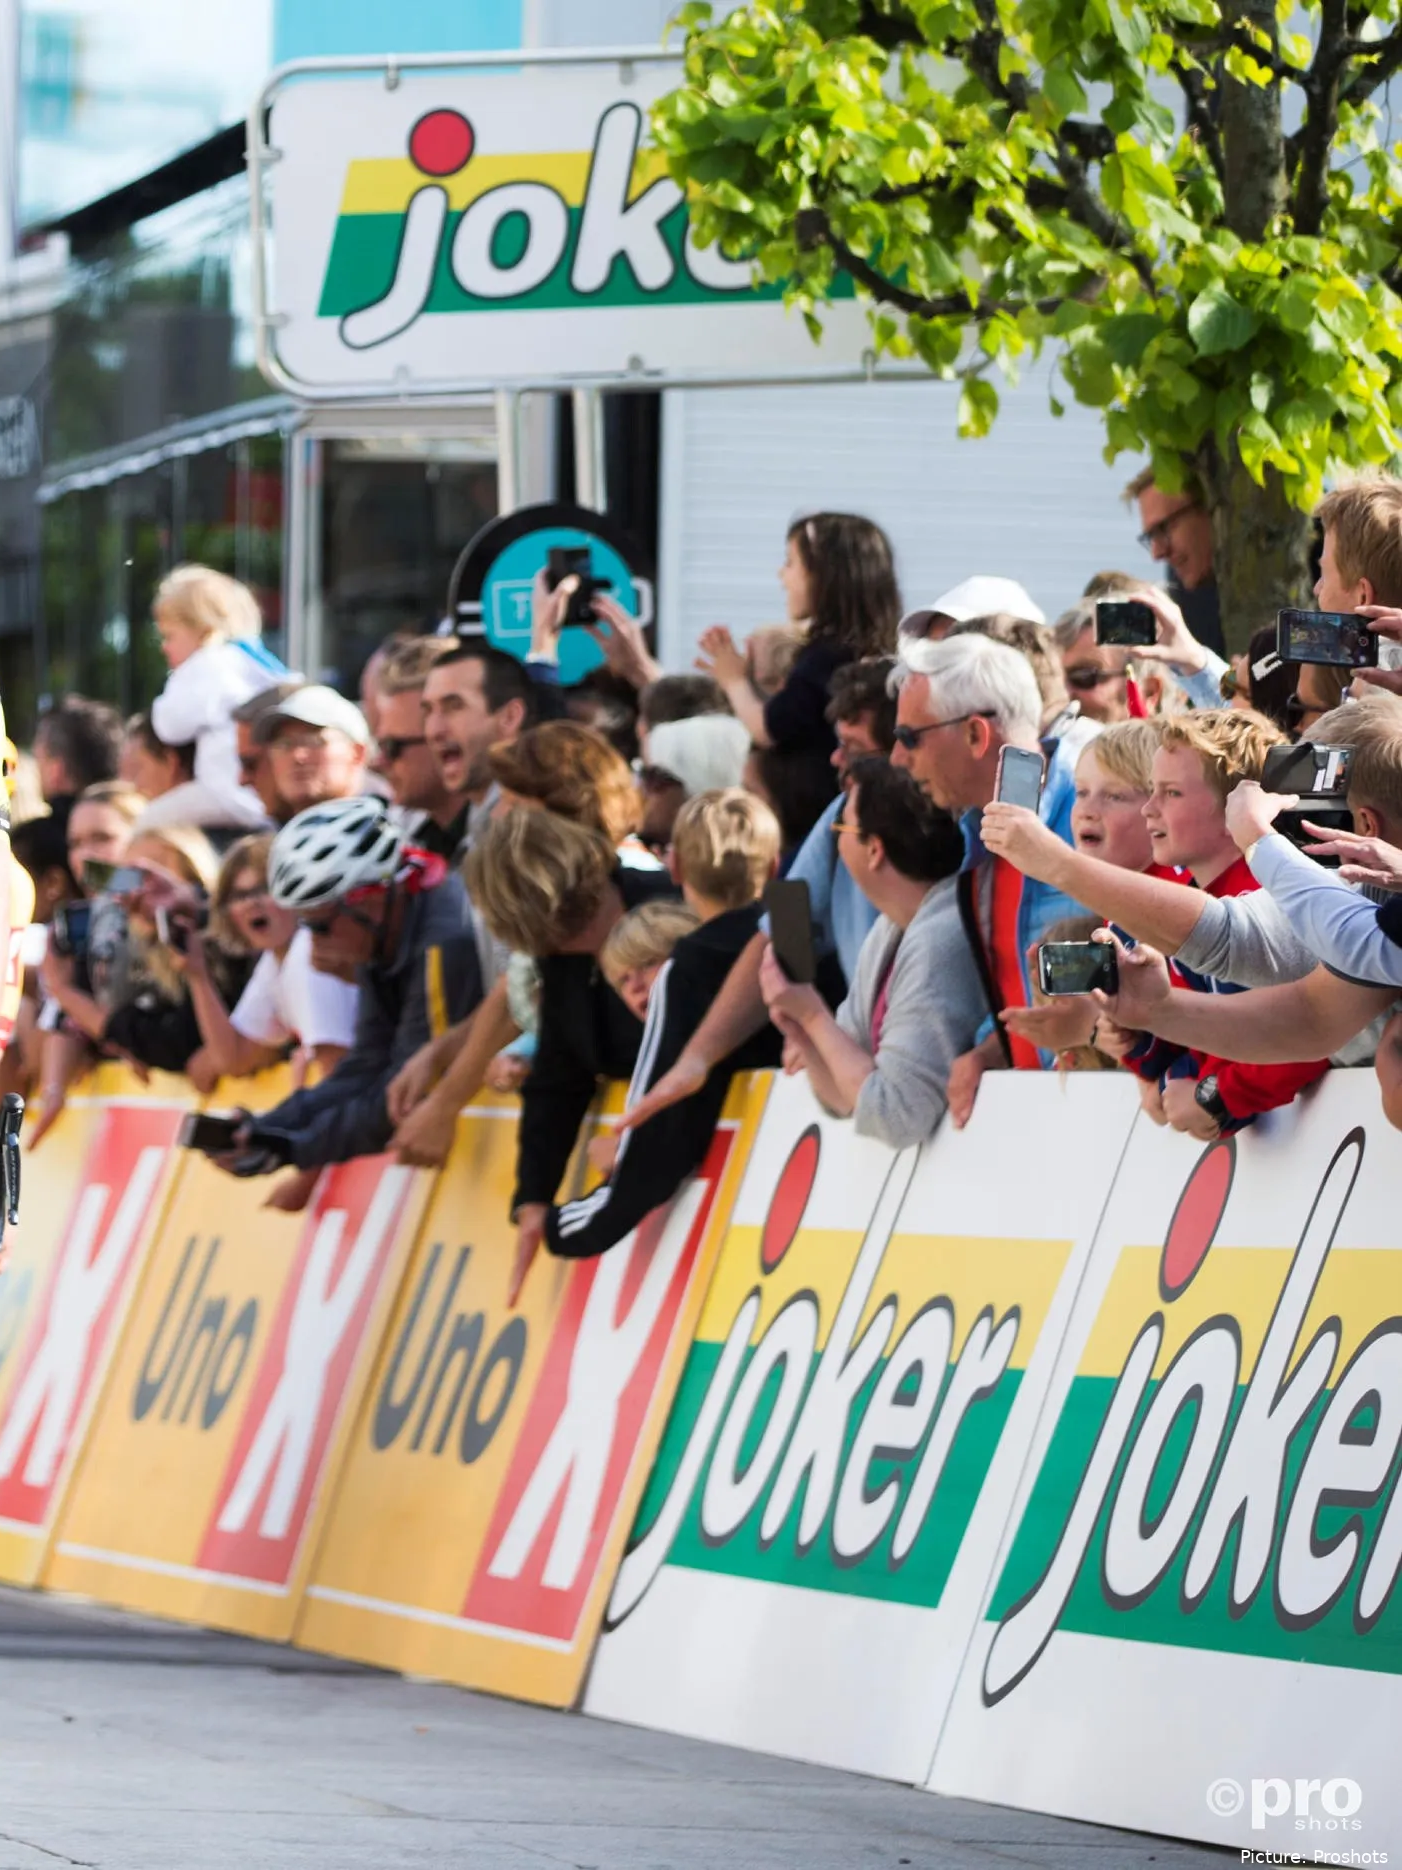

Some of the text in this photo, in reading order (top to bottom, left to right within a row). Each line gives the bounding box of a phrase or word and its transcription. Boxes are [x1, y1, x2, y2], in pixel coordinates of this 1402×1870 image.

[338, 101, 766, 349] jok
[131, 1234, 260, 1431] Uno
[217, 1165, 416, 1540] X
[370, 1178, 709, 1591] Uno X
[601, 1124, 1022, 1635] joker
